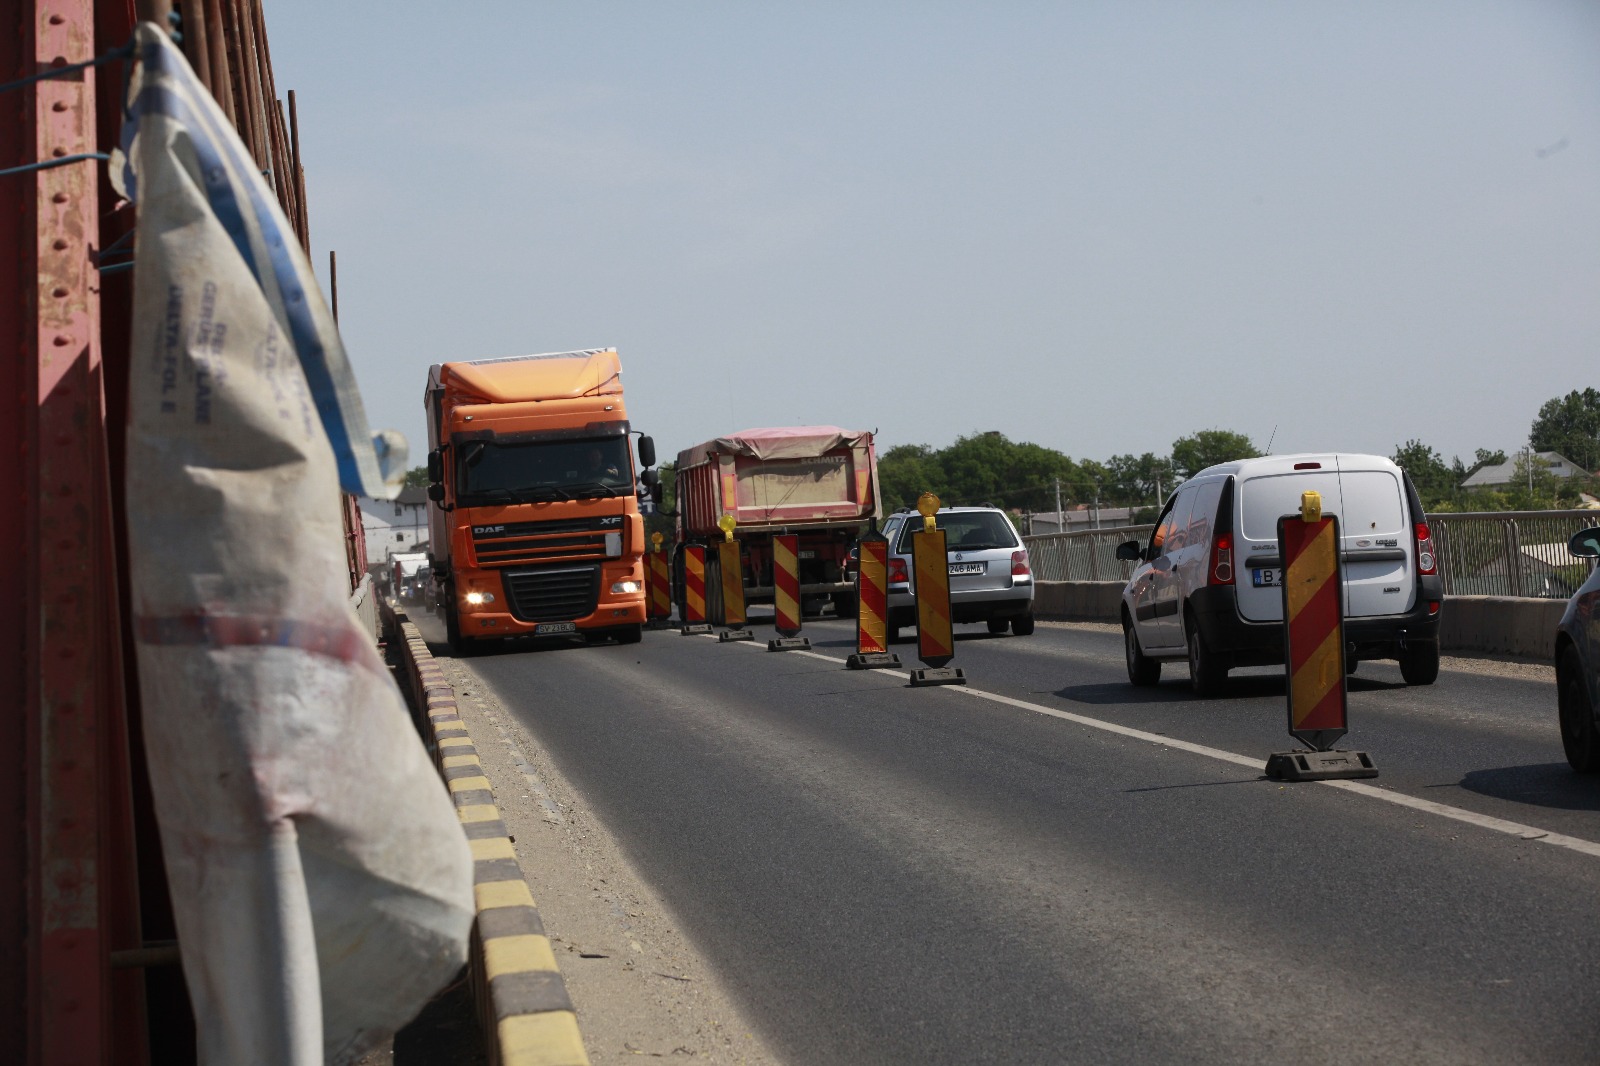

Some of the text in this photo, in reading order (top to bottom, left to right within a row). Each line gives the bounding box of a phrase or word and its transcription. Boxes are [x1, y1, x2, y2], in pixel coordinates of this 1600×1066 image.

[800, 455, 847, 465] SCHMITZ
[600, 517, 622, 525] XF
[474, 525, 505, 534] DAF
[1263, 570, 1274, 583] B
